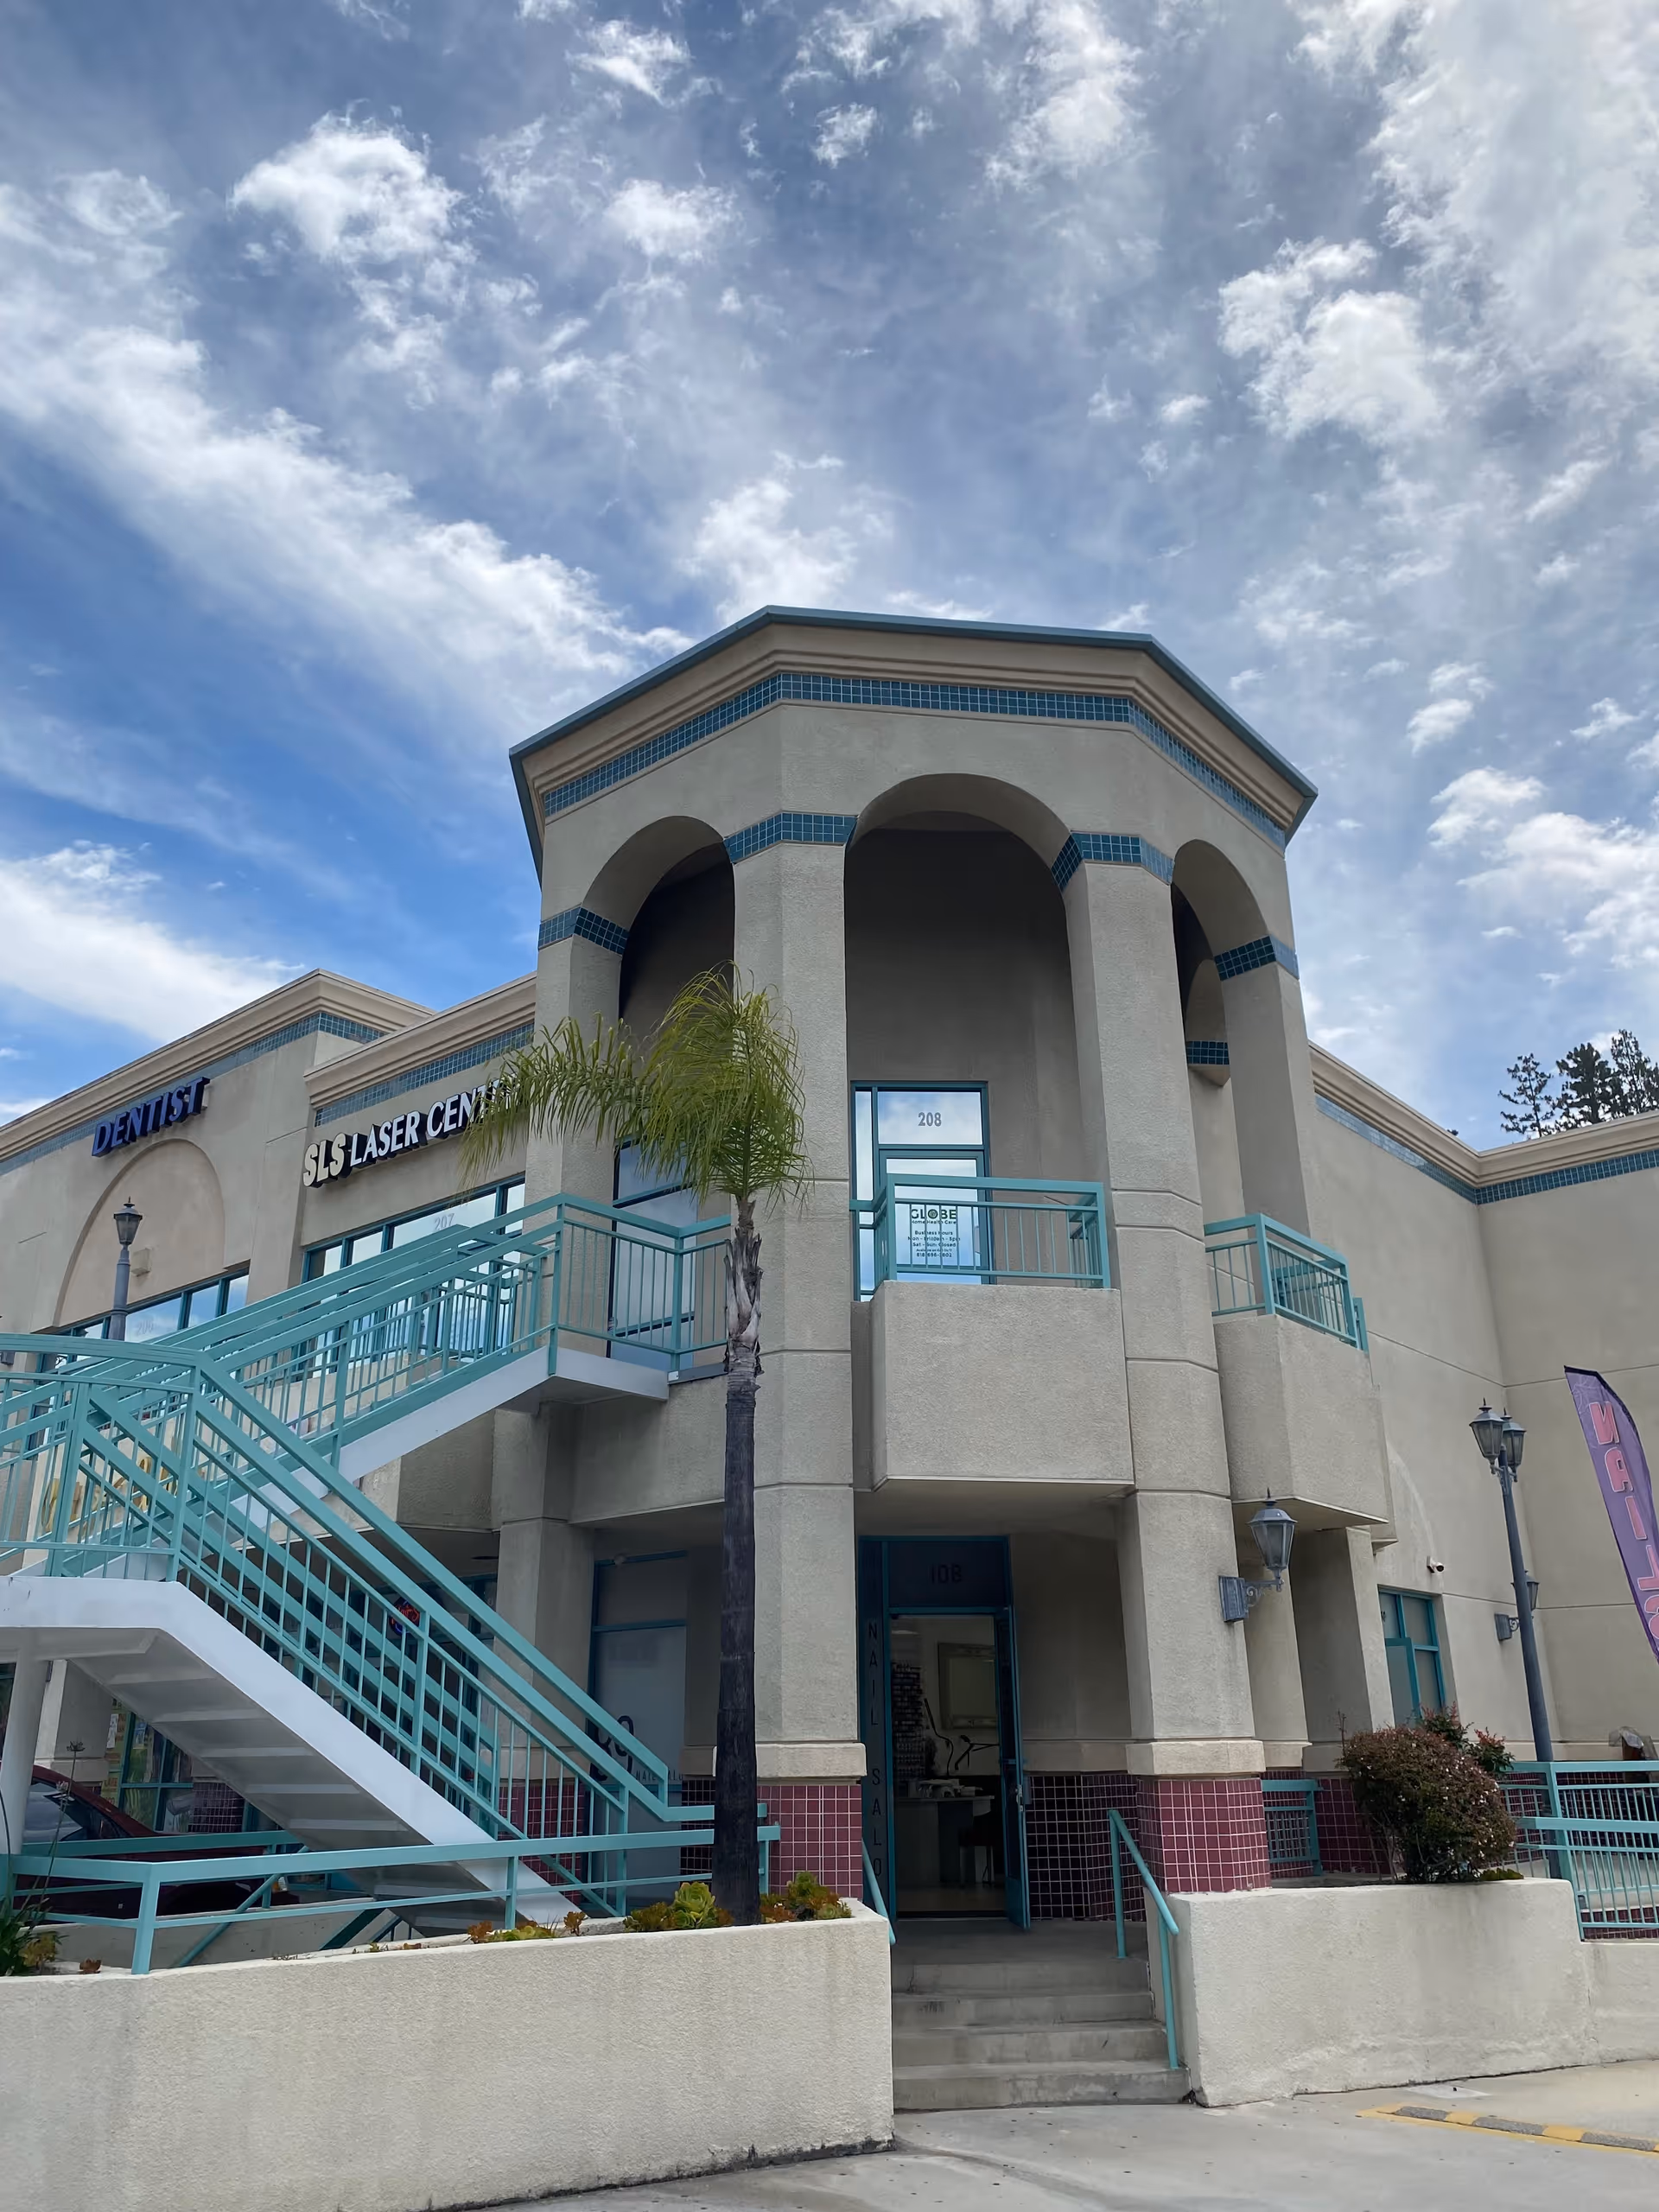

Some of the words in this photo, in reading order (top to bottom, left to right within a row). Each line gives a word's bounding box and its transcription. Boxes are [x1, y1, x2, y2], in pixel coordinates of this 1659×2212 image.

[92, 1077, 208, 1157] DENTIST
[302, 1133, 349, 1188] SLS
[350, 1109, 423, 1167] LASER
[427, 1075, 517, 1139] CENT
[918, 1111, 942, 1127] 208
[434, 1212, 454, 1231] 207
[910, 1209, 957, 1219] GLOBE
[931, 1563, 963, 1585] 108
[868, 1622, 879, 1726] NAIL
[872, 1767, 882, 1878] SALO
